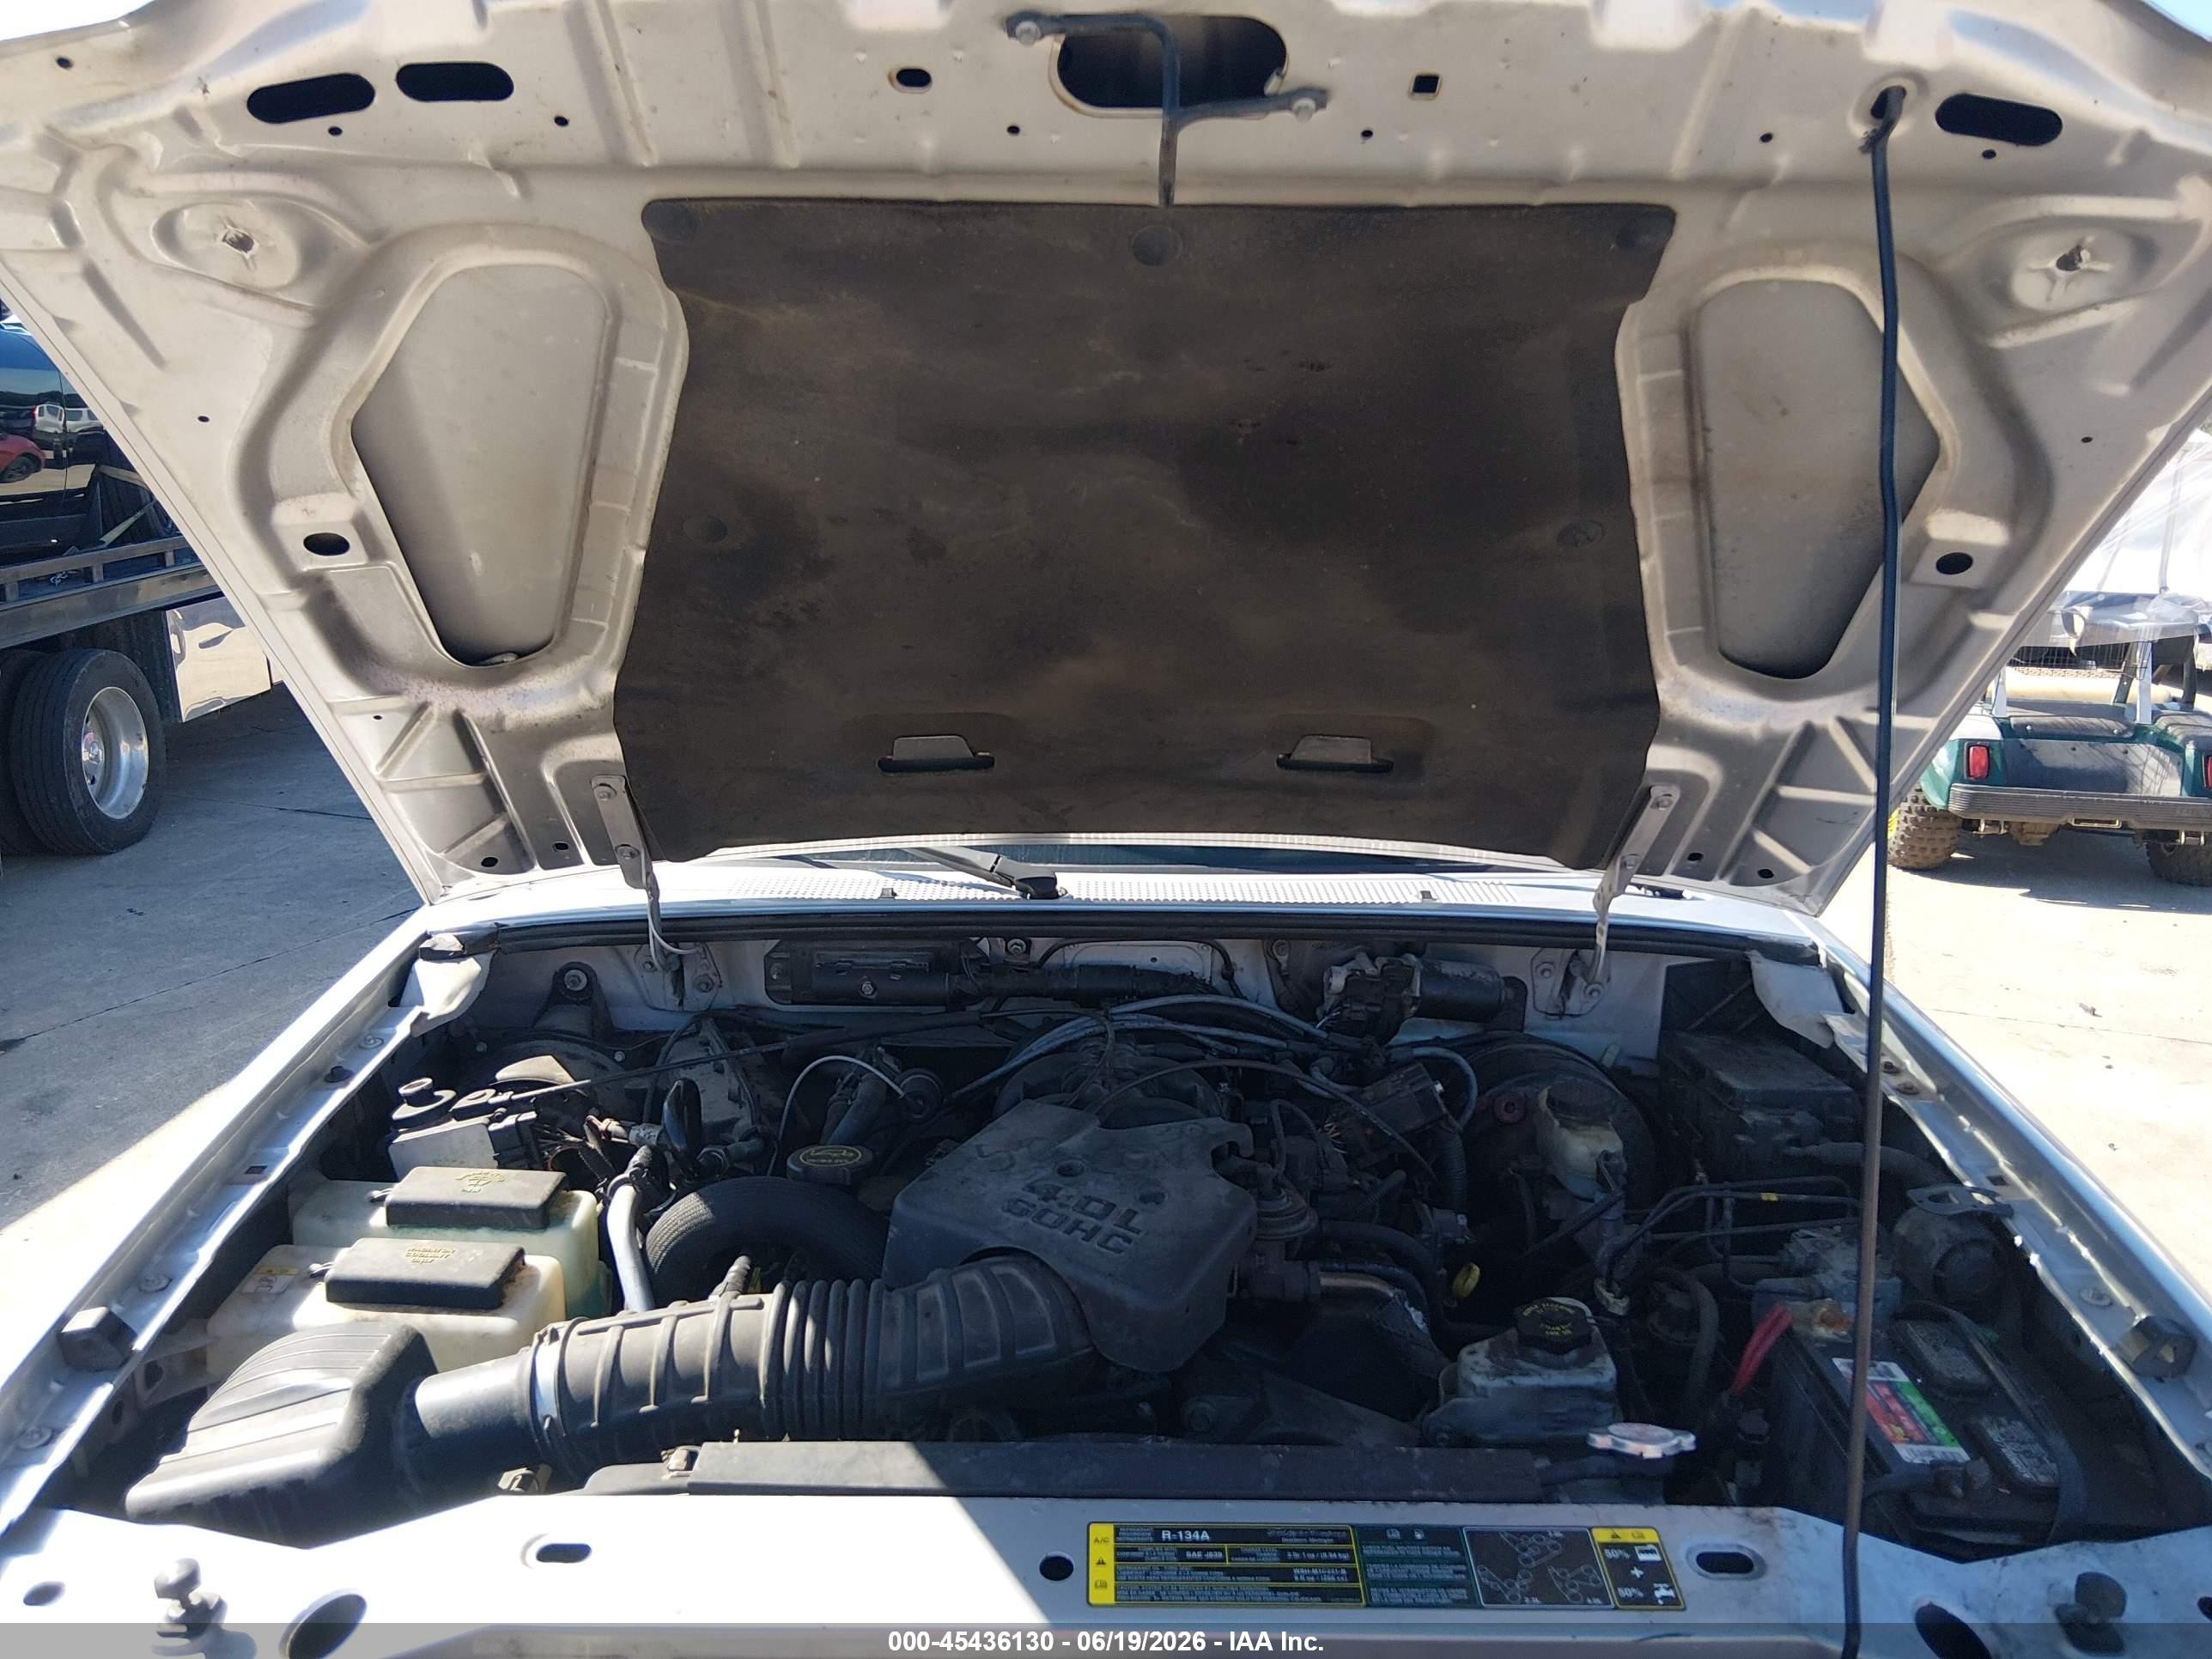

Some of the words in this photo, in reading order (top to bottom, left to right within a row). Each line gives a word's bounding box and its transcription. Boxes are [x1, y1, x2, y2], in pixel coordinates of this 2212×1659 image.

[1000, 1197, 1133, 1255] SOHC
[1161, 1529, 1210, 1541] R-134A
[1604, 1548, 1630, 1559] 50%
[1618, 1588, 1644, 1598] 50%
